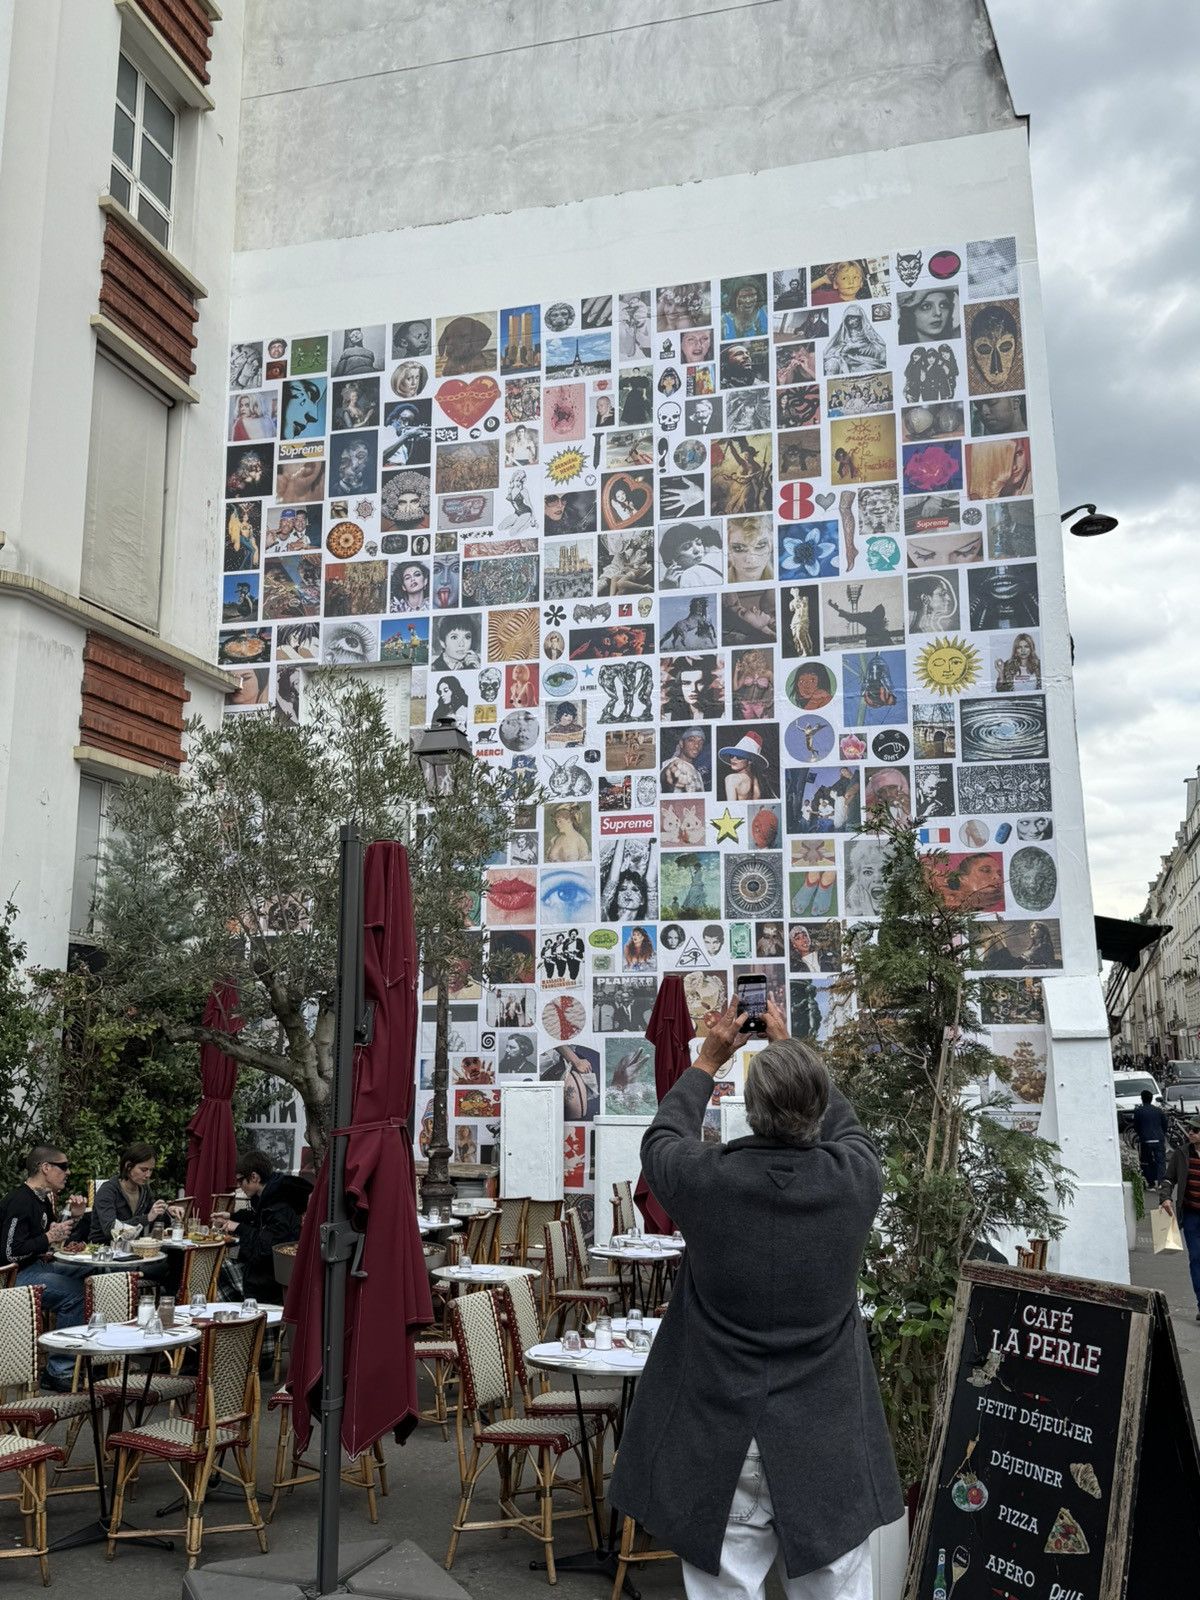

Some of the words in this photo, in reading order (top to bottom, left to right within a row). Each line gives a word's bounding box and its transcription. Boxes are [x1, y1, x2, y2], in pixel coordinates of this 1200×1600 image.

[280, 444, 323, 458] Supreme
[916, 520, 949, 528] Supreme
[475, 749, 504, 757] MERCI
[883, 753, 899, 761] SHIT
[602, 818, 653, 832] Supreme
[1022, 1305, 1074, 1334] CAFÉ
[990, 1328, 1020, 1355] LA
[1027, 1332, 1102, 1374] PERLE
[976, 1396, 1017, 1420] PETIT
[990, 1450, 1063, 1488] DÉJEUNER
[998, 1504, 1040, 1535] PIZZA
[985, 1554, 1036, 1588] APÉRO
